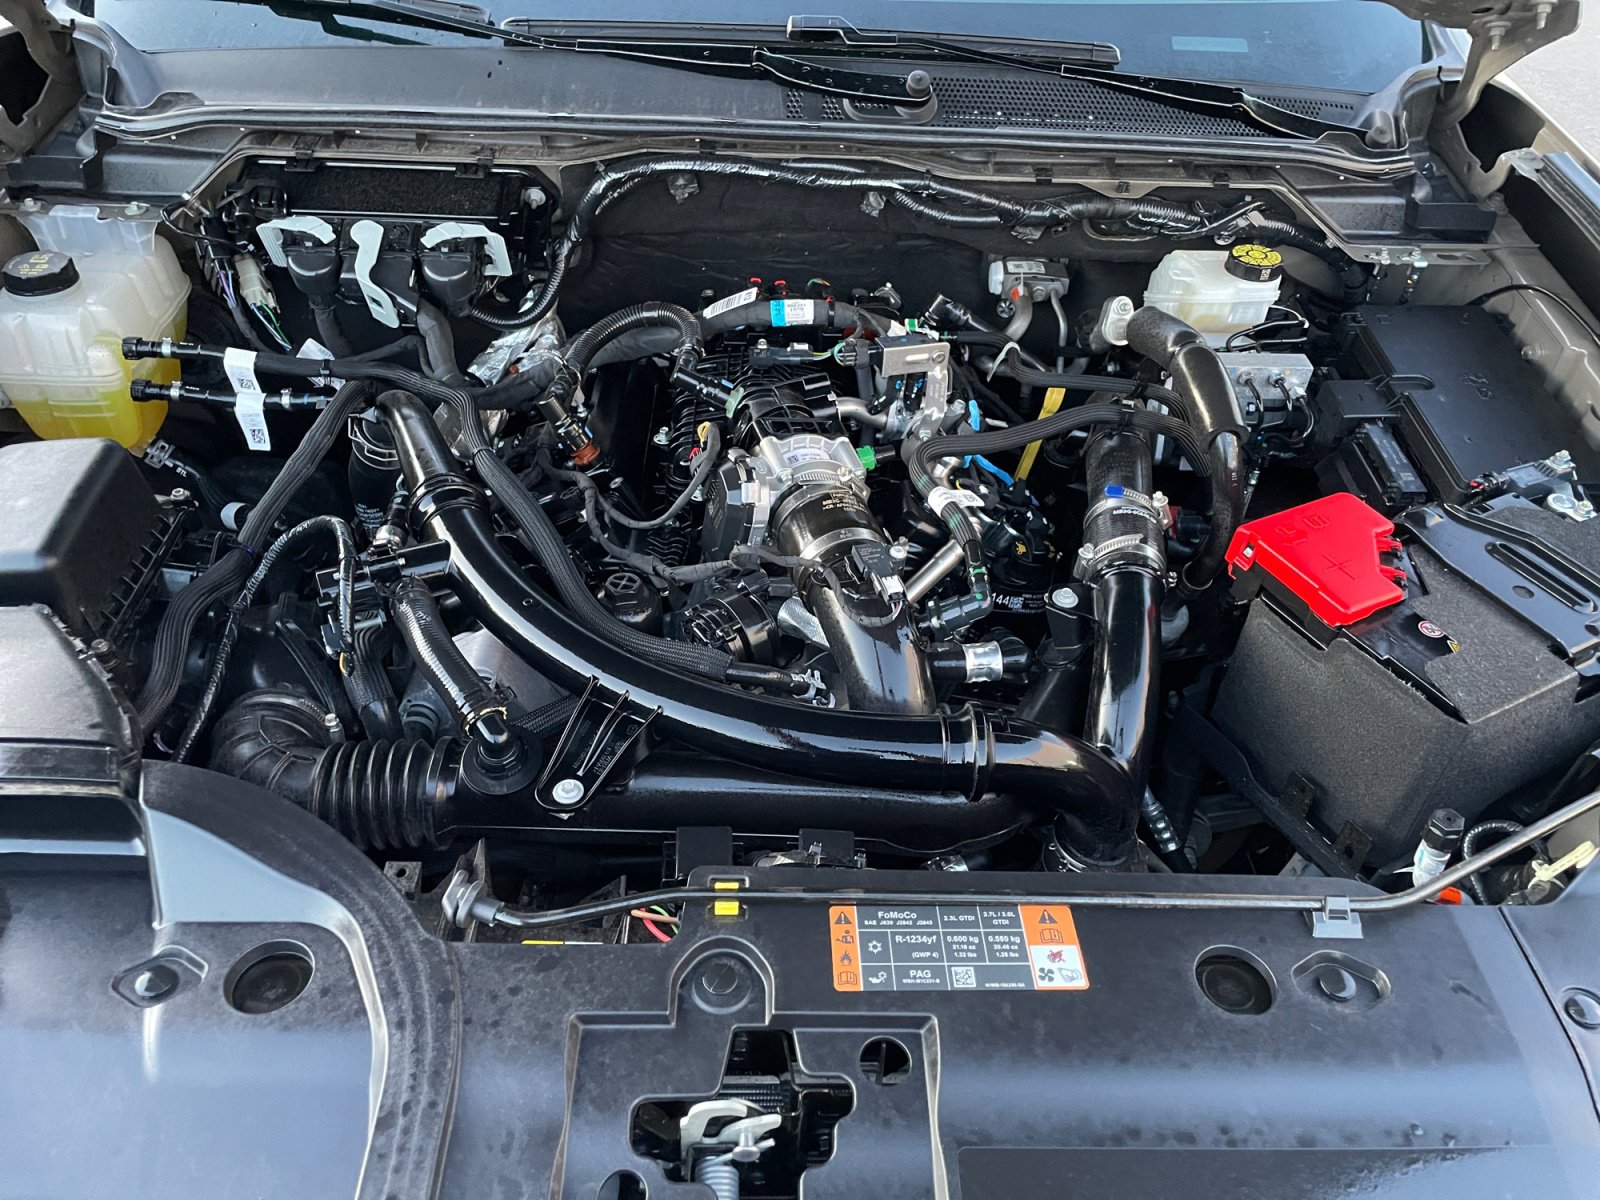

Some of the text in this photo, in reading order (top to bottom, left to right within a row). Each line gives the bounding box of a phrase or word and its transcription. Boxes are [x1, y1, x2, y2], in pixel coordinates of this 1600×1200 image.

[877, 911, 917, 919] FoMoCo
[895, 935, 937, 945] R-1234yf
[969, 935, 979, 944] kg
[1010, 935, 1021, 944] kg
[911, 951, 939, 959] (GWP 4)
[909, 970, 932, 979] PAG
